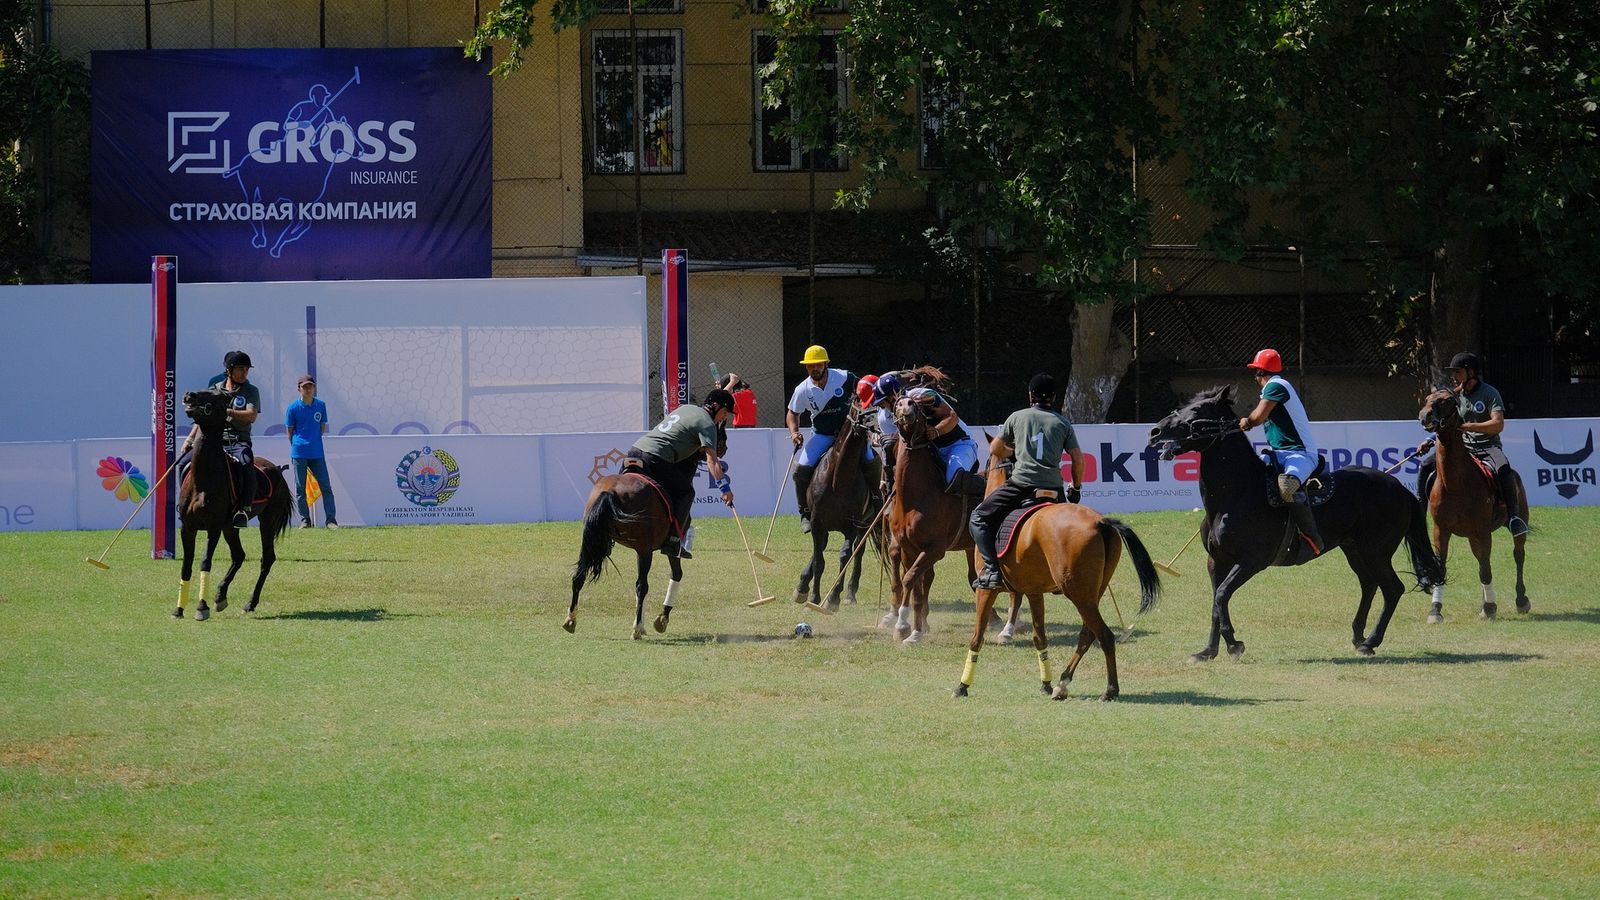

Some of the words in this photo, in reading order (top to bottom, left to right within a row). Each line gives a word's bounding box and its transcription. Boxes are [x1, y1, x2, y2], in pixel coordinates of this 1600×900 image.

[247, 120, 418, 164] GROSS
[350, 171, 418, 185] INSURANCE
[169, 202, 293, 221] СТРАХОВАЯ
[299, 201, 417, 220] КОМПАНИЯ
[164, 370, 174, 390] U.S.
[677, 362, 687, 381] U.S.
[677, 382, 687, 405] POL
[164, 392, 174, 421] POLO
[658, 414, 680, 432] 3
[164, 424, 174, 455] ASSN.
[1030, 431, 1044, 460] 1
[1537, 467, 1597, 487] BUKA
[1081, 490, 1116, 498] GROUP
[1133, 489, 1193, 497] COMPANIES
